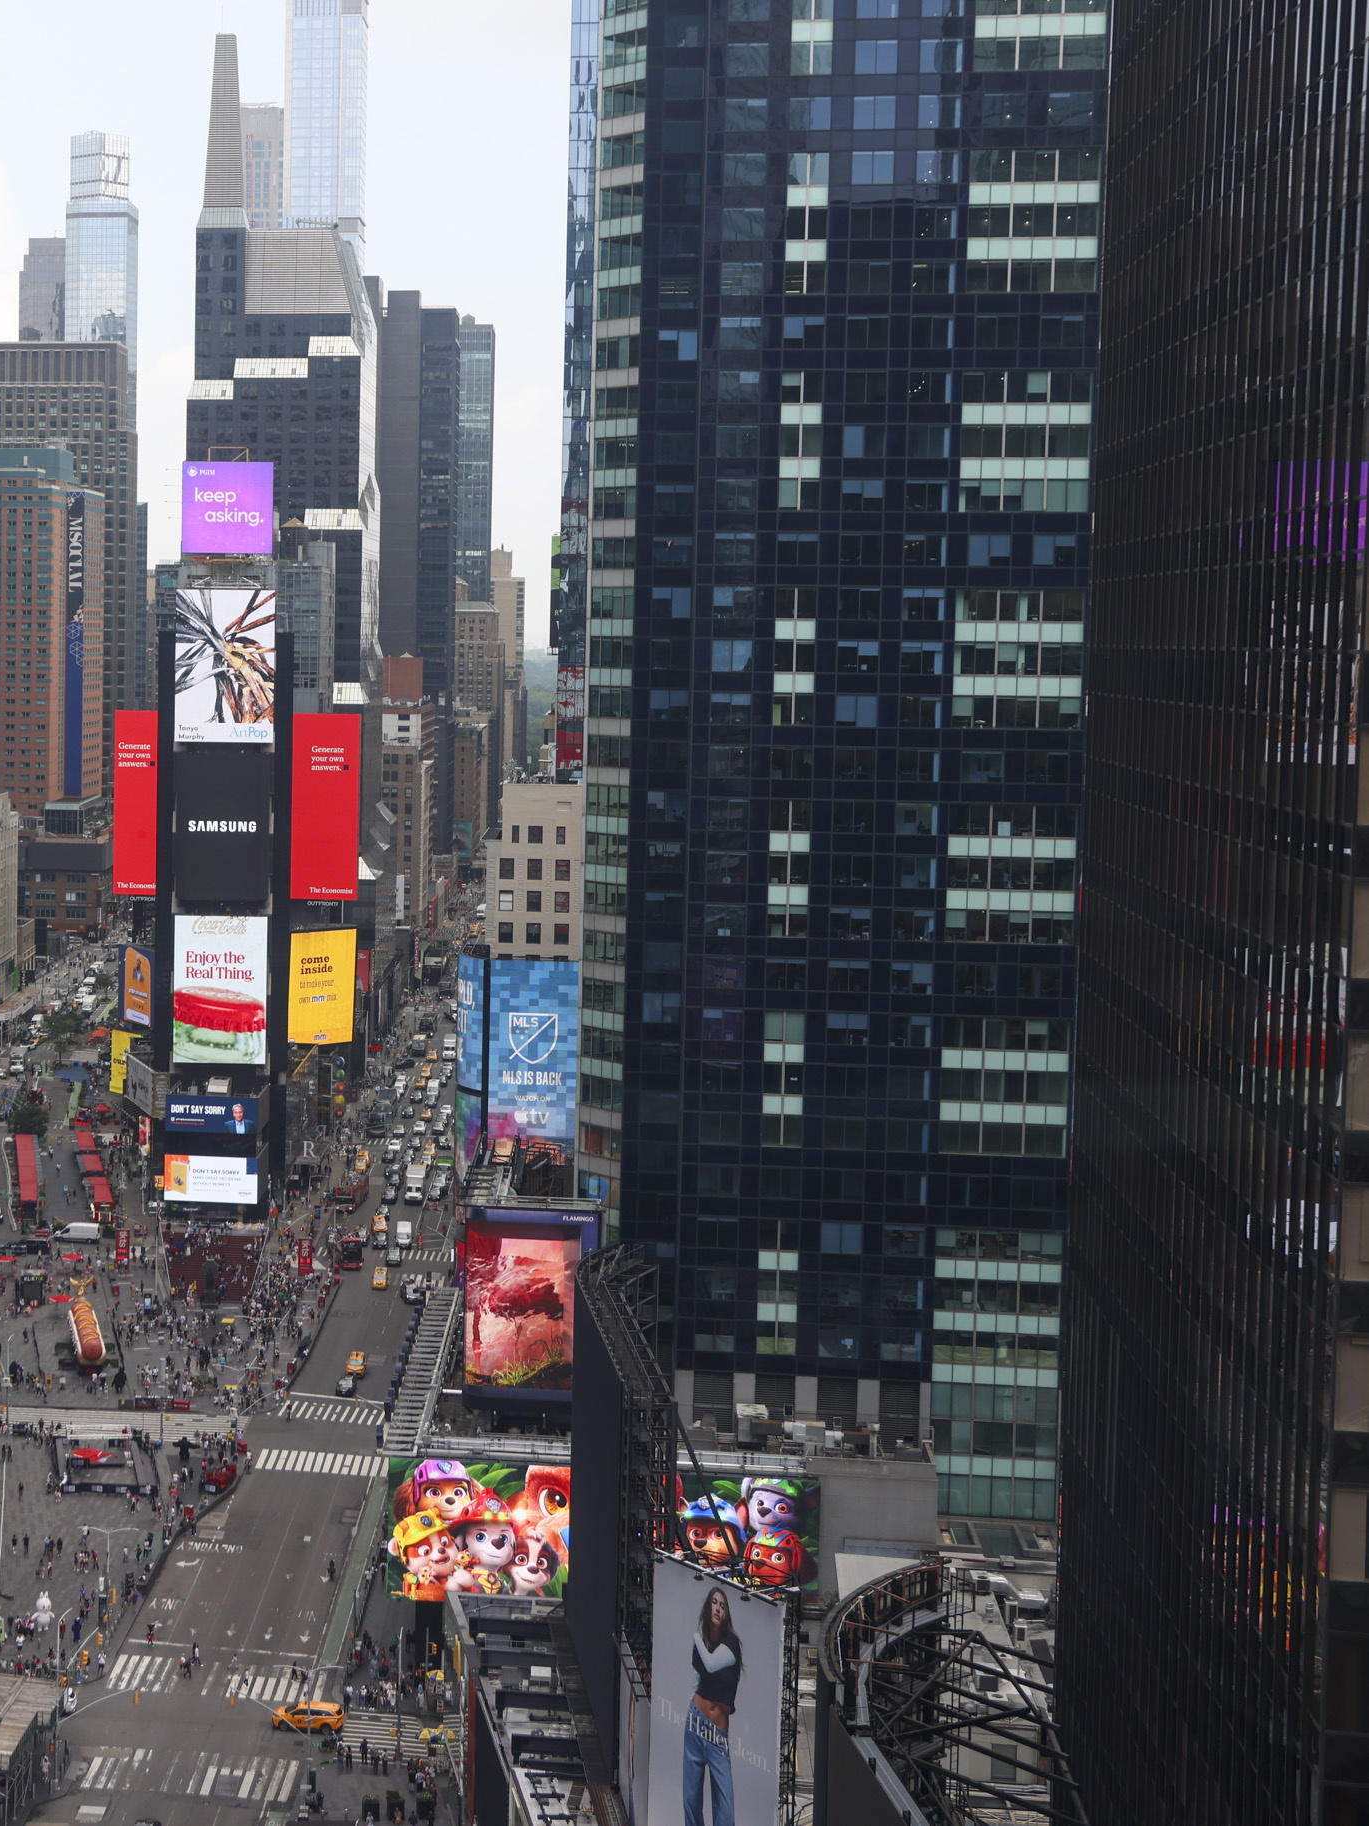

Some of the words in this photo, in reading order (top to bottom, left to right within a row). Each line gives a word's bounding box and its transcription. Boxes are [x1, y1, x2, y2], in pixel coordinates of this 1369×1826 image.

[194, 487, 237, 507] keep
[204, 507, 264, 527] asking.
[178, 733, 205, 741] Murphy
[229, 726, 269, 739] ArtPop
[118, 742, 151, 750] Generate
[311, 745, 345, 754] Generate
[118, 752, 135, 760] your
[188, 820, 257, 833] SAMSUNG
[322, 887, 353, 895] Economist
[186, 951, 221, 966] Enjoy
[223, 952, 245, 964] the
[301, 956, 330, 964] come
[186, 967, 213, 979] Real
[215, 967, 255, 982] Thing.
[300, 964, 333, 975] inside
[299, 981, 306, 989] to
[306, 979, 321, 989] make
[321, 979, 334, 989] your
[512, 1017, 539, 1028] MLS
[502, 1070, 522, 1084] MLS
[524, 1071, 534, 1084] IS
[535, 1072, 563, 1086] BACK
[514, 1094, 538, 1102] WATCH
[170, 1104, 190, 1114] DON'T
[190, 1105, 204, 1115] SAY
[204, 1106, 226, 1116] SORRY
[302, 1140, 318, 1158] R
[562, 1215, 594, 1223] FLAMINGO
[119, 1230, 128, 1248] tkts
[301, 1240, 311, 1257] tkts
[657, 1695, 686, 1727] The
[687, 1711, 729, 1757] Hailey
[734, 1737, 771, 1773] Jean.
